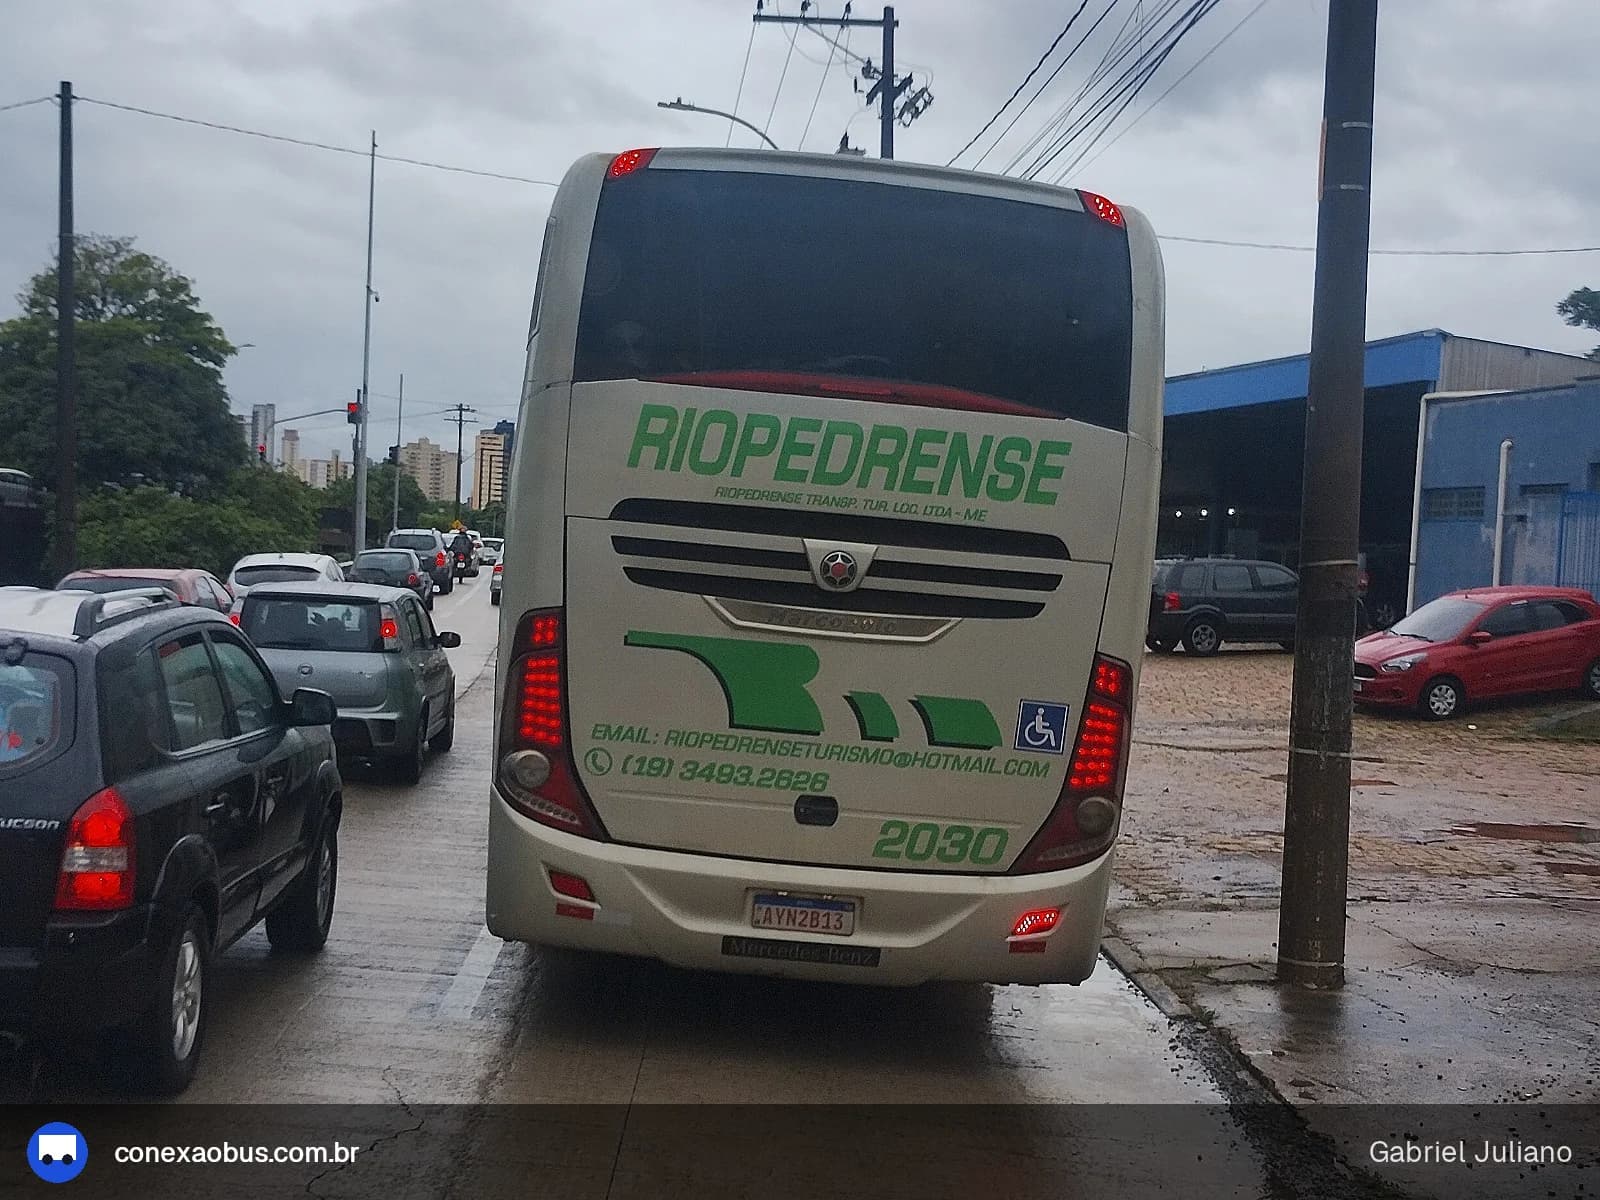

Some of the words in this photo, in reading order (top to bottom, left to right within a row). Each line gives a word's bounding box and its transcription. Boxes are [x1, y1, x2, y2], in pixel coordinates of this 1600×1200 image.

[627, 403, 1072, 506] RIOPEDRENSE
[714, 486, 802, 505] RIOPEDRENSE
[806, 493, 857, 510] TRANSP.
[862, 499, 889, 511] TUR.
[922, 504, 953, 518] LTDA
[963, 508, 988, 522] ME
[769, 607, 897, 634] Marcoolo
[591, 723, 659, 745] EMAIL:
[664, 729, 1050, 778] RIOPEDRENSETURISMO@HOTMAIL.COM
[621, 754, 674, 778] (19)
[678, 760, 830, 793] 3493.2626
[0, 817, 60, 829] ucson
[872, 819, 1009, 865] 2030
[762, 906, 844, 931] AYN2B13
